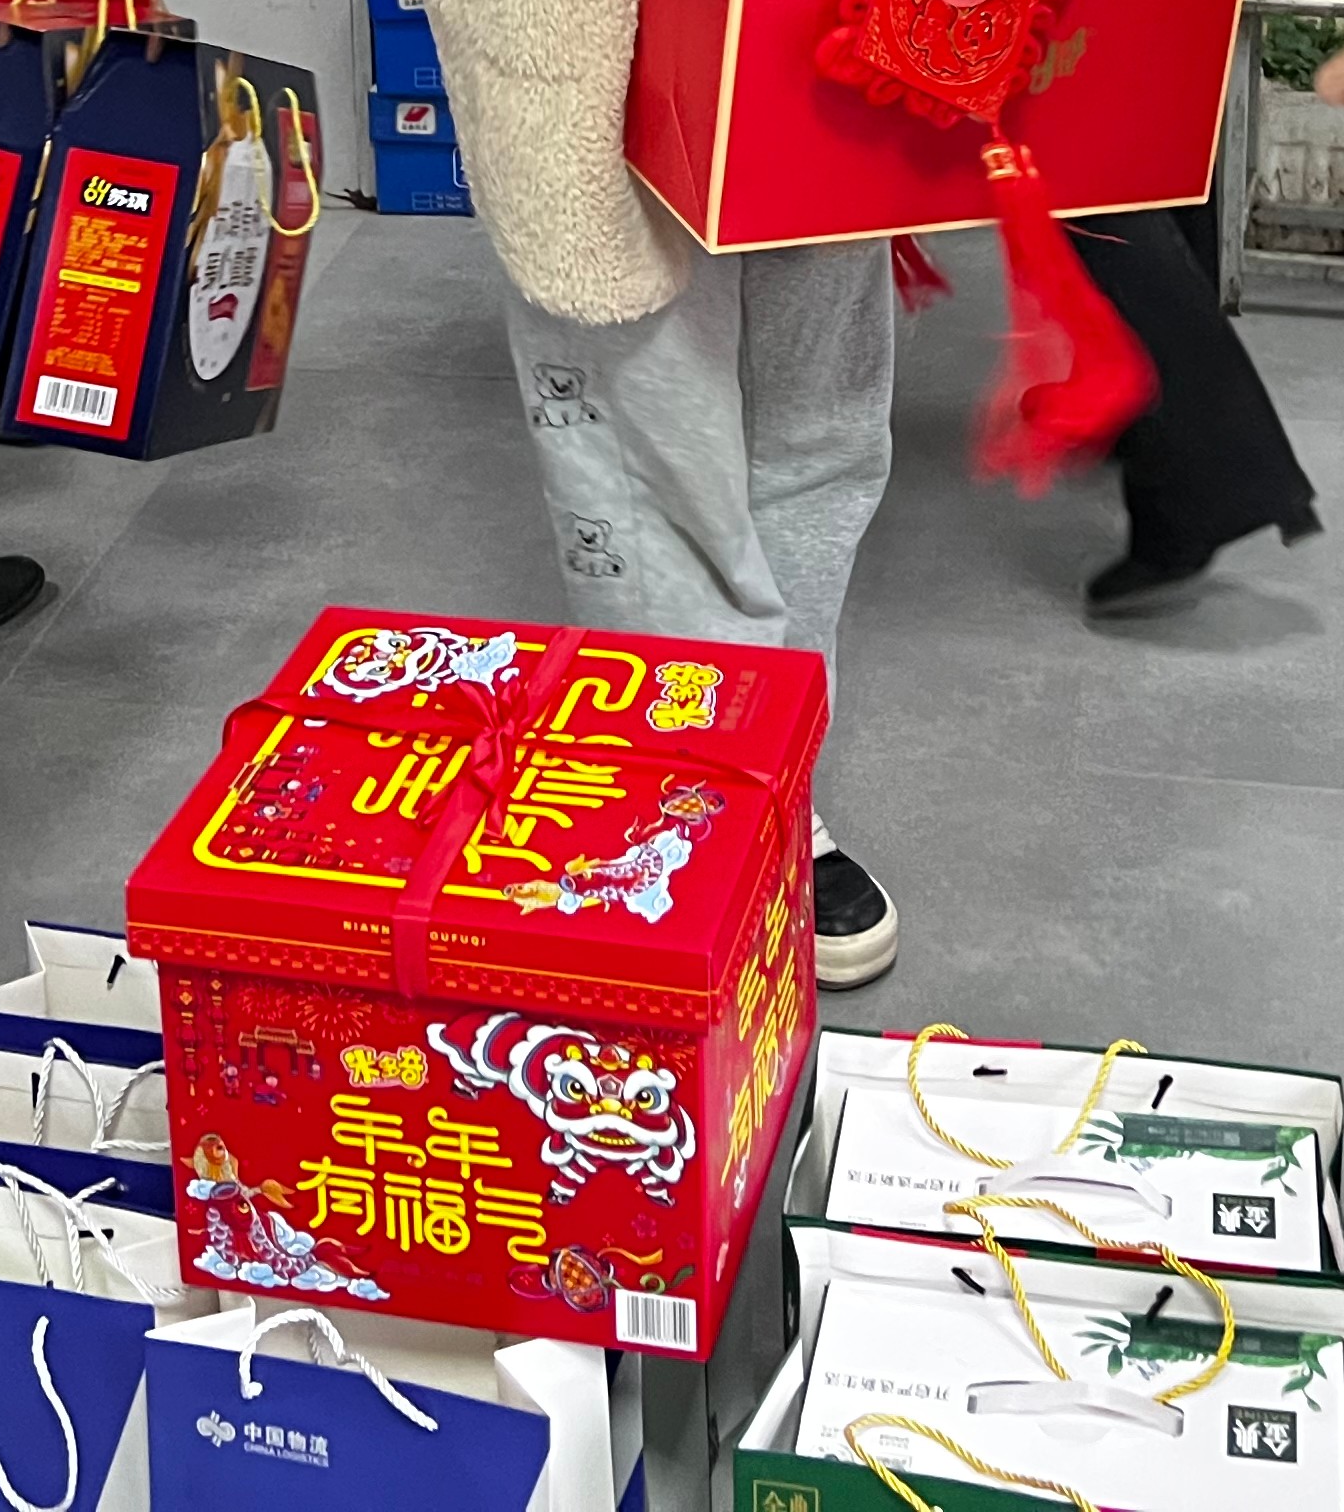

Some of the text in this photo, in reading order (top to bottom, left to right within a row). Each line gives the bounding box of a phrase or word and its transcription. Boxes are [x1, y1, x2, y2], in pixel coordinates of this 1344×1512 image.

[342, 920, 487, 947] NIANN OUFUQI
[340, 1044, 429, 1089] 米多奇
[329, 1092, 514, 1180] 年年
[295, 1156, 549, 1266] 有福气
[1216, 1202, 1271, 1236] 金典
[243, 1421, 330, 1457] 中国物流
[1232, 1418, 1292, 1458] 金典
